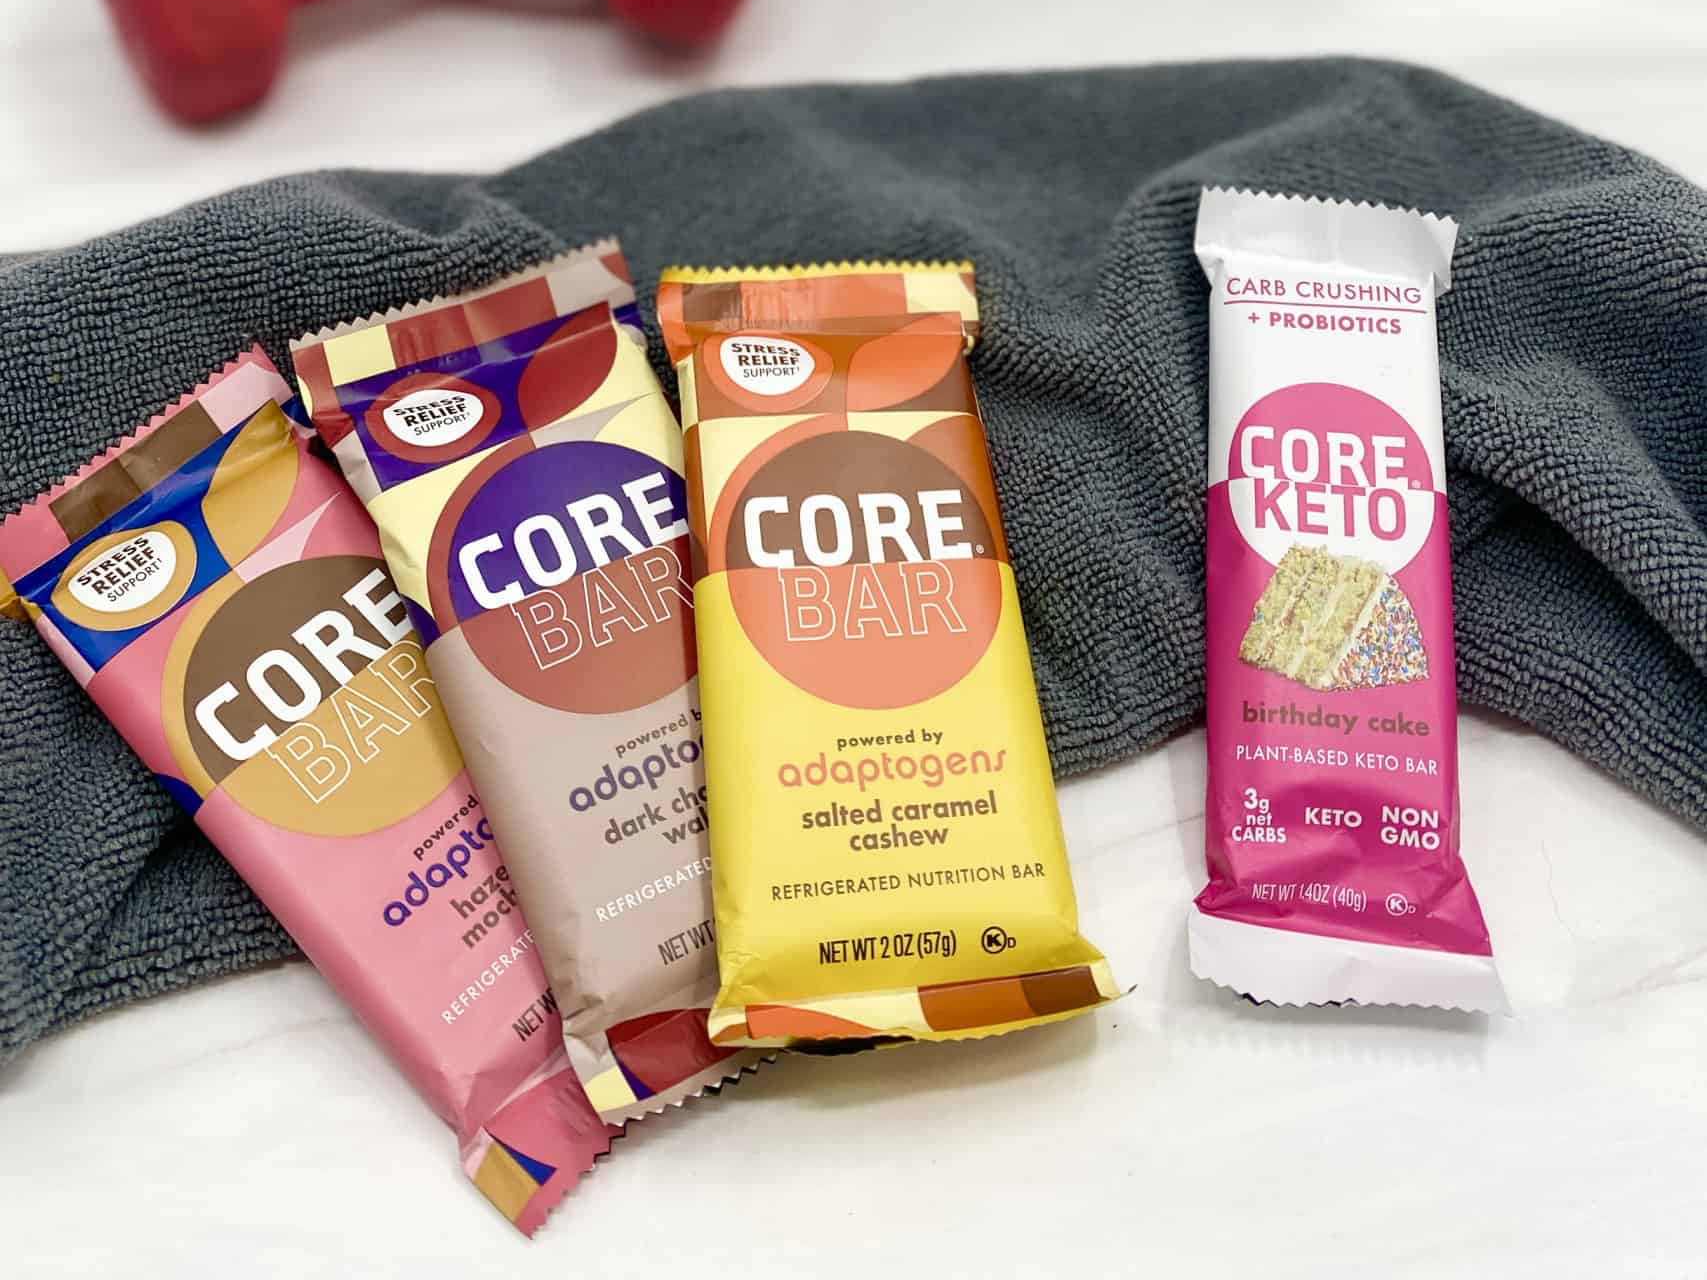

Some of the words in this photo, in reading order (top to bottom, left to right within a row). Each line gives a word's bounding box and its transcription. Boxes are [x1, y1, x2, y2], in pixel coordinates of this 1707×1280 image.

[1226, 277, 1287, 297] CARB
[1295, 280, 1422, 304] CRUSHING
[1269, 311, 1402, 334] PROBIOTICS
[730, 343, 801, 357] STRESS
[737, 354, 800, 367] RELIEF
[392, 396, 466, 416] STRESS
[403, 403, 467, 427] RELIEF
[1253, 478, 1407, 541] KETO
[458, 472, 690, 610] CORE
[77, 537, 150, 586] STRESS
[91, 546, 155, 595] RELIEF
[510, 545, 695, 671] BAR
[777, 560, 968, 641] BAR
[195, 568, 414, 761] CORE
[615, 713, 689, 759] powered
[1242, 701, 1360, 734] birthday
[1368, 712, 1430, 737] cake
[837, 730, 916, 752] powered
[921, 728, 944, 745] by
[778, 748, 1007, 793] adaptogens
[1236, 745, 1349, 767] PLANT-BASED
[1355, 752, 1400, 770] KETO
[1405, 759, 1438, 776] BAR
[413, 793, 480, 861] powered
[604, 803, 668, 845] dark
[802, 799, 882, 829] salted
[892, 790, 998, 824] caramel
[1244, 787, 1270, 814] 3g
[1304, 807, 1363, 828] KETO
[1381, 805, 1439, 829] NON
[1246, 812, 1273, 826] net
[849, 823, 949, 852] cashew
[1231, 825, 1288, 844] CARBS
[1380, 827, 1441, 851] GMO
[450, 865, 510, 920] haze
[771, 874, 901, 901] REFRIGERATED
[908, 865, 1006, 889] NUTRITION
[1012, 862, 1046, 879] BAR
[1252, 884, 1277, 901] NET
[1279, 884, 1297, 902] WT
[1333, 887, 1367, 913] (40g)
[657, 931, 689, 965] NET
[686, 918, 714, 950] WT
[819, 940, 849, 965] NET
[851, 937, 878, 961] WT
[880, 935, 891, 959] 2
[893, 933, 915, 957] OZ
[917, 929, 957, 959] (57g)
[512, 1003, 545, 1042] NET
